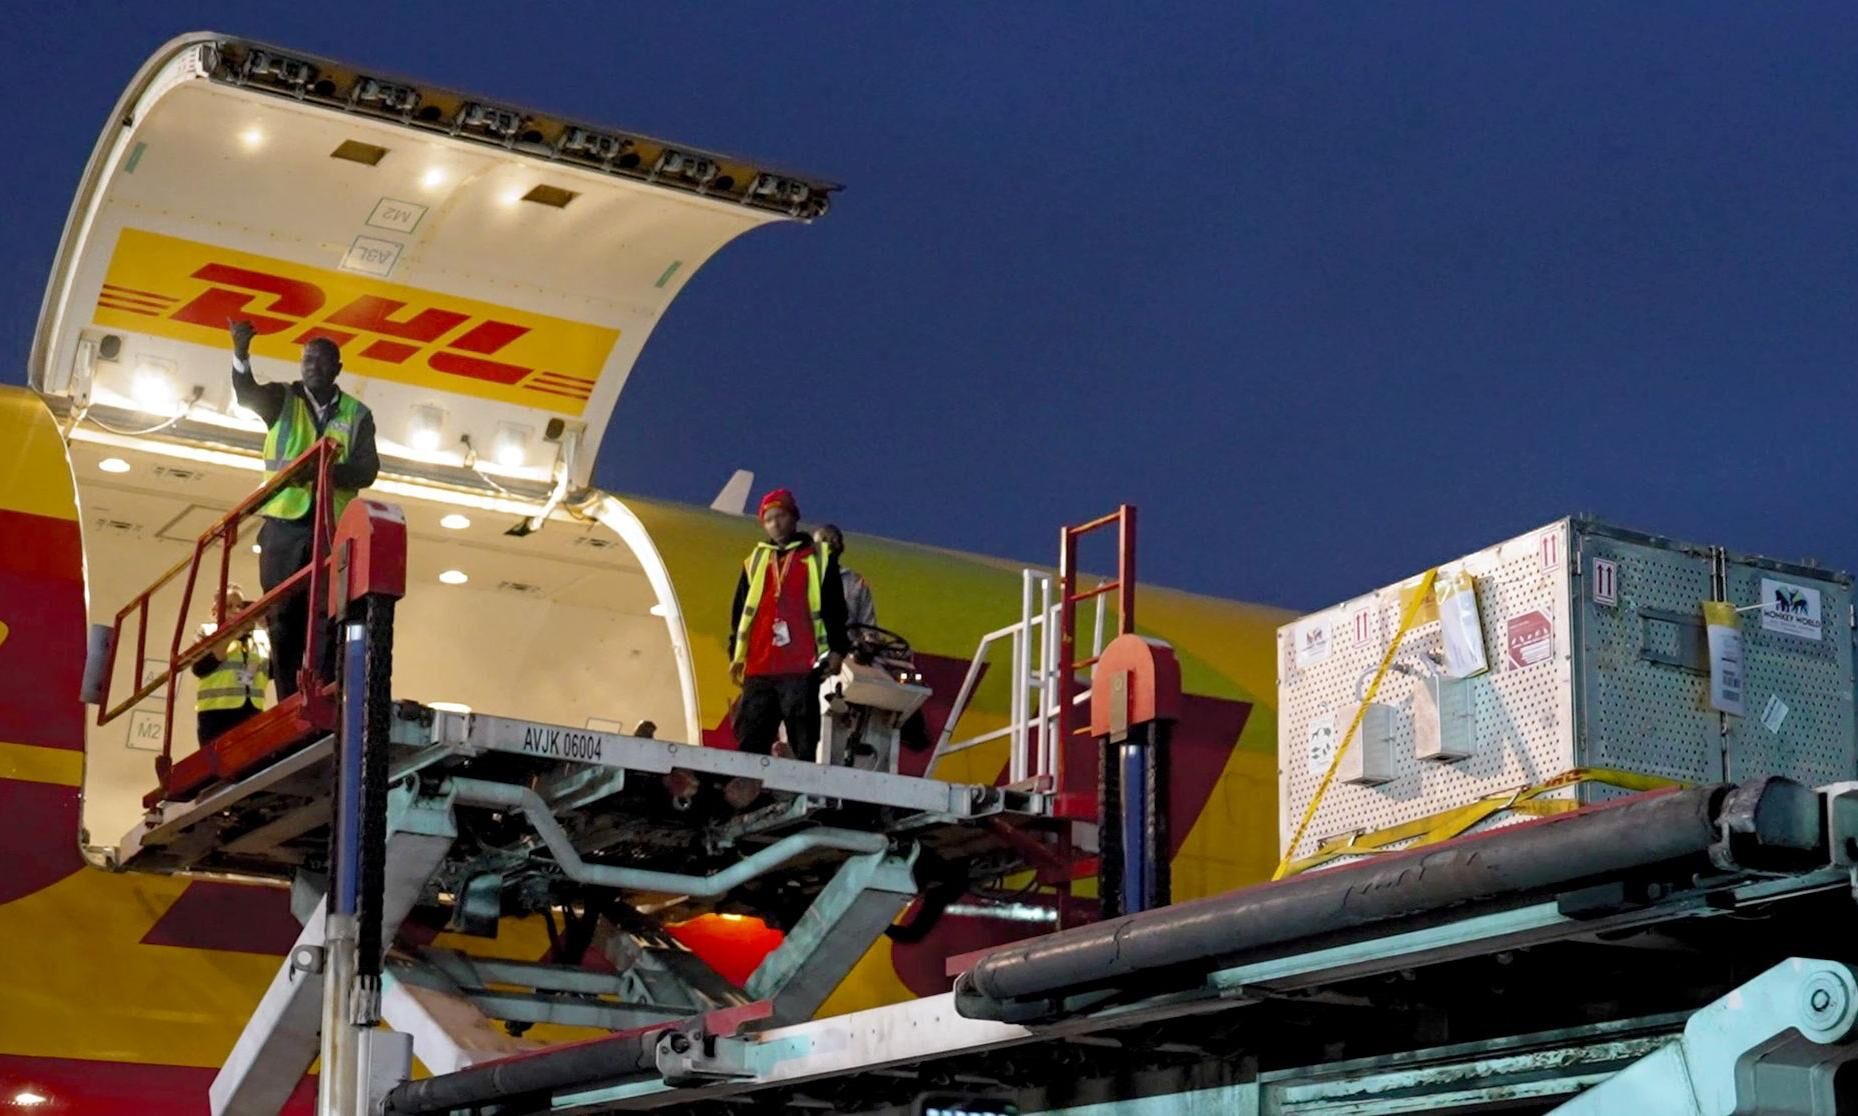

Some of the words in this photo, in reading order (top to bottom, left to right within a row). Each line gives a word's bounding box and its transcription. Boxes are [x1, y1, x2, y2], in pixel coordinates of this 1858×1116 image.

[382, 207, 412, 224] M2
[168, 262, 534, 386] DHL
[1796, 616, 1821, 628] WORLD
[137, 722, 162, 740] M2
[523, 726, 560, 755] AVJK
[563, 732, 602, 760] 06004
